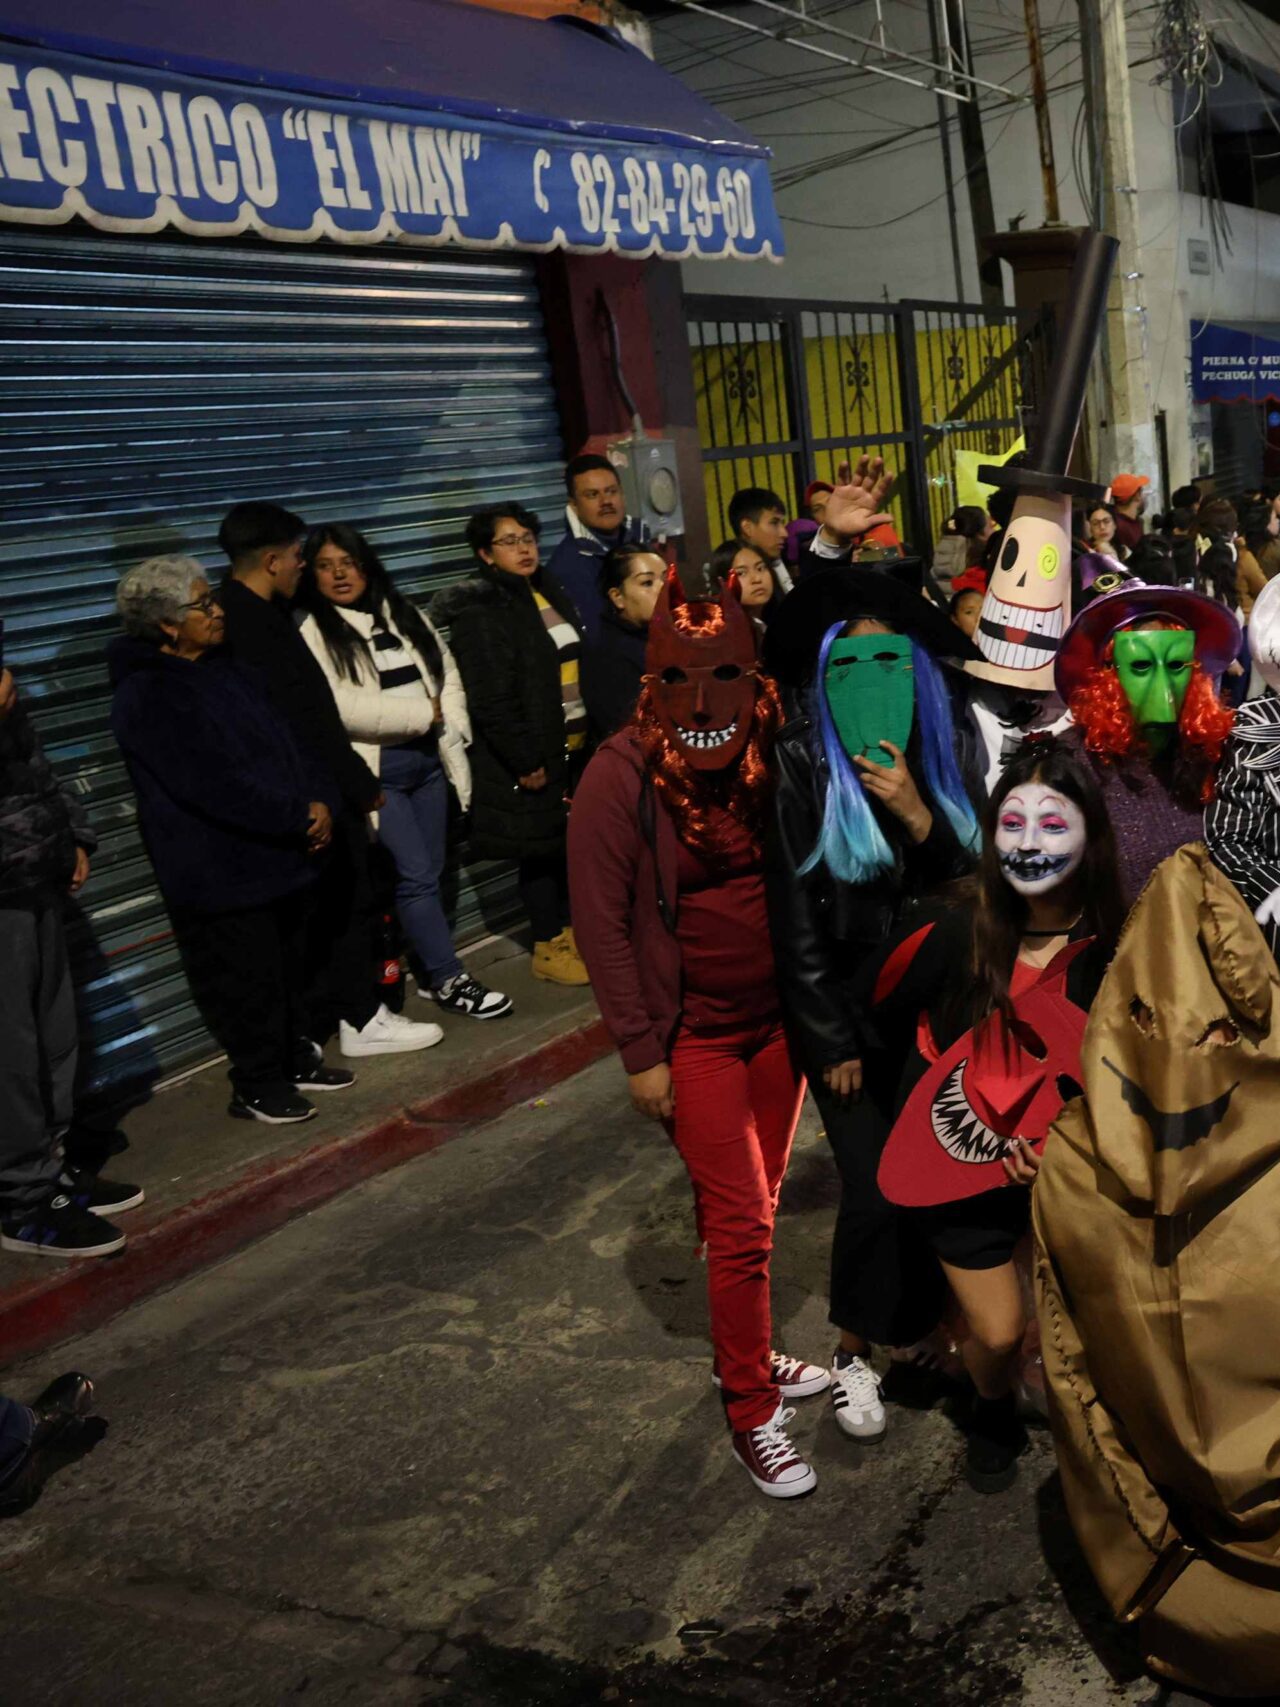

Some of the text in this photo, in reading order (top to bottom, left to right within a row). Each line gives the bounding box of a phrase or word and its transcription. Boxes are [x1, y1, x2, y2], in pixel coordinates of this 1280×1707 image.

[0, 62, 279, 208] ECTRICO
[570, 152, 756, 239] 82-84-29-60
[1202, 355, 1246, 366] PIERNA
[1202, 370, 1257, 381] PECHUGA
